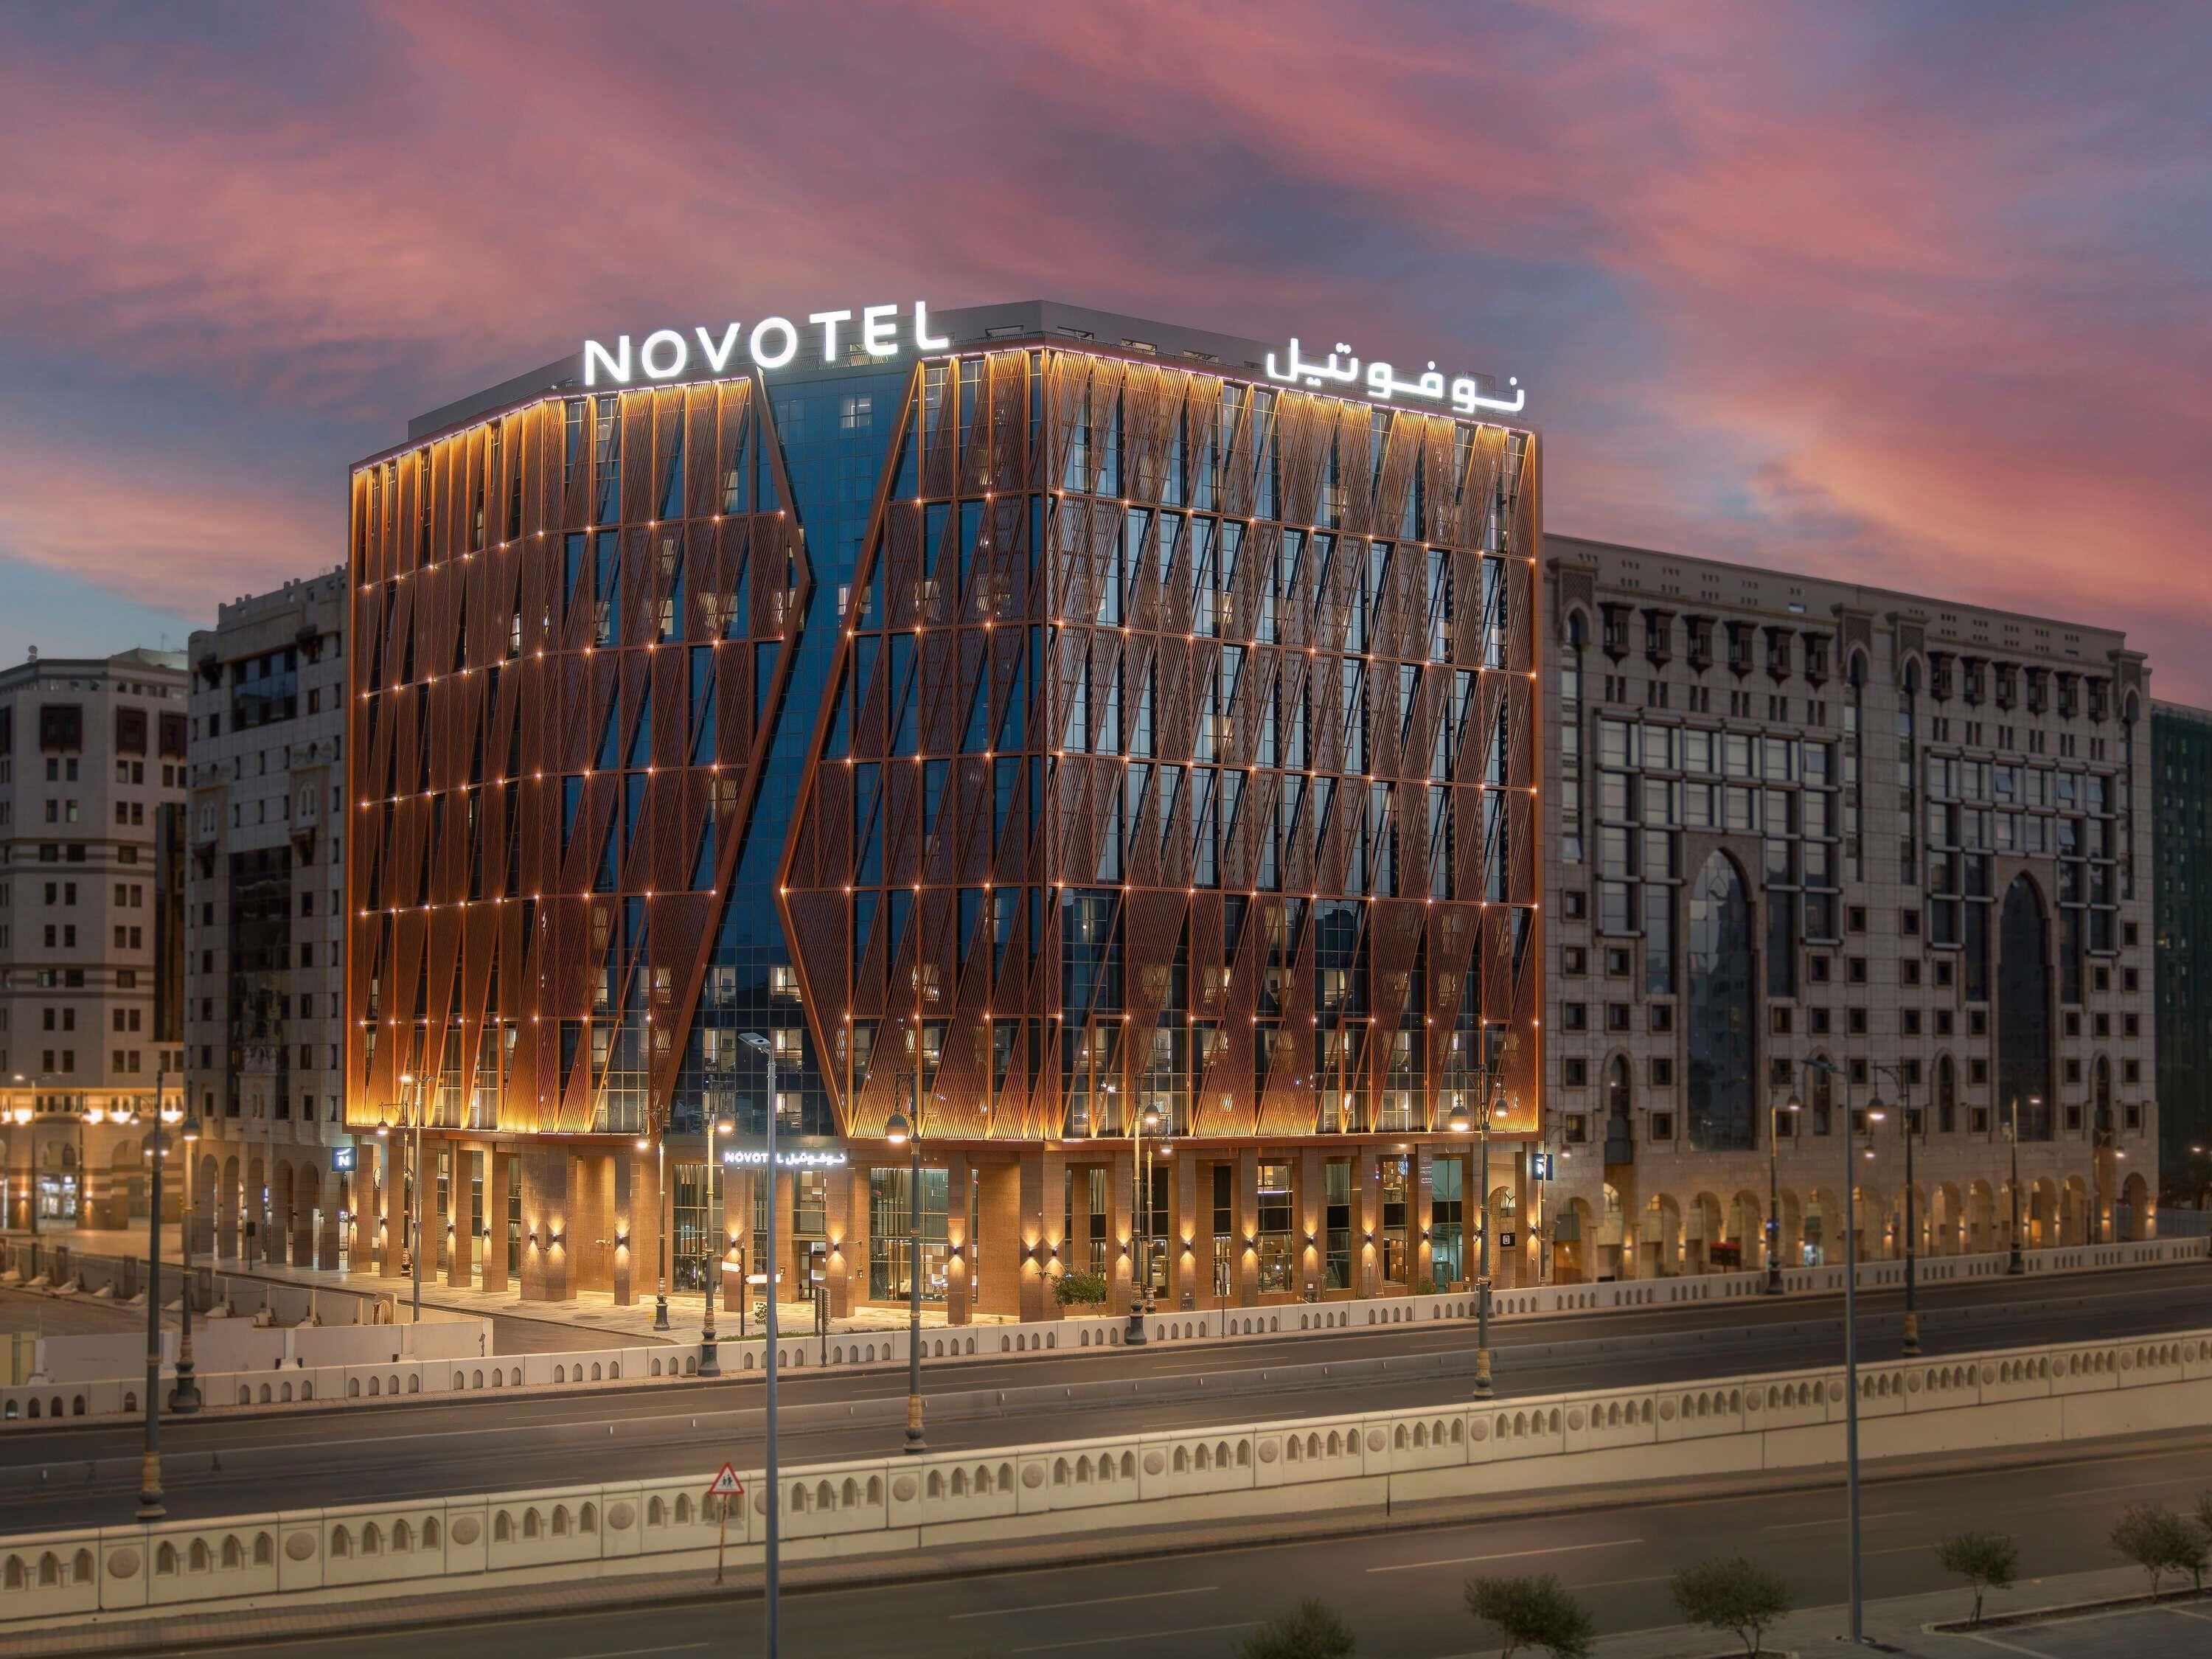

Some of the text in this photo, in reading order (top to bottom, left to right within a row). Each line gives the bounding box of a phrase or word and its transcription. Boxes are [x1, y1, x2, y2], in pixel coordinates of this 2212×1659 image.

[584, 301, 949, 385] NOVOTEL
[1267, 338, 1525, 414] نوفوتيل
[338, 1155, 349, 1166] N
[724, 1152, 785, 1164] NOVOTL
